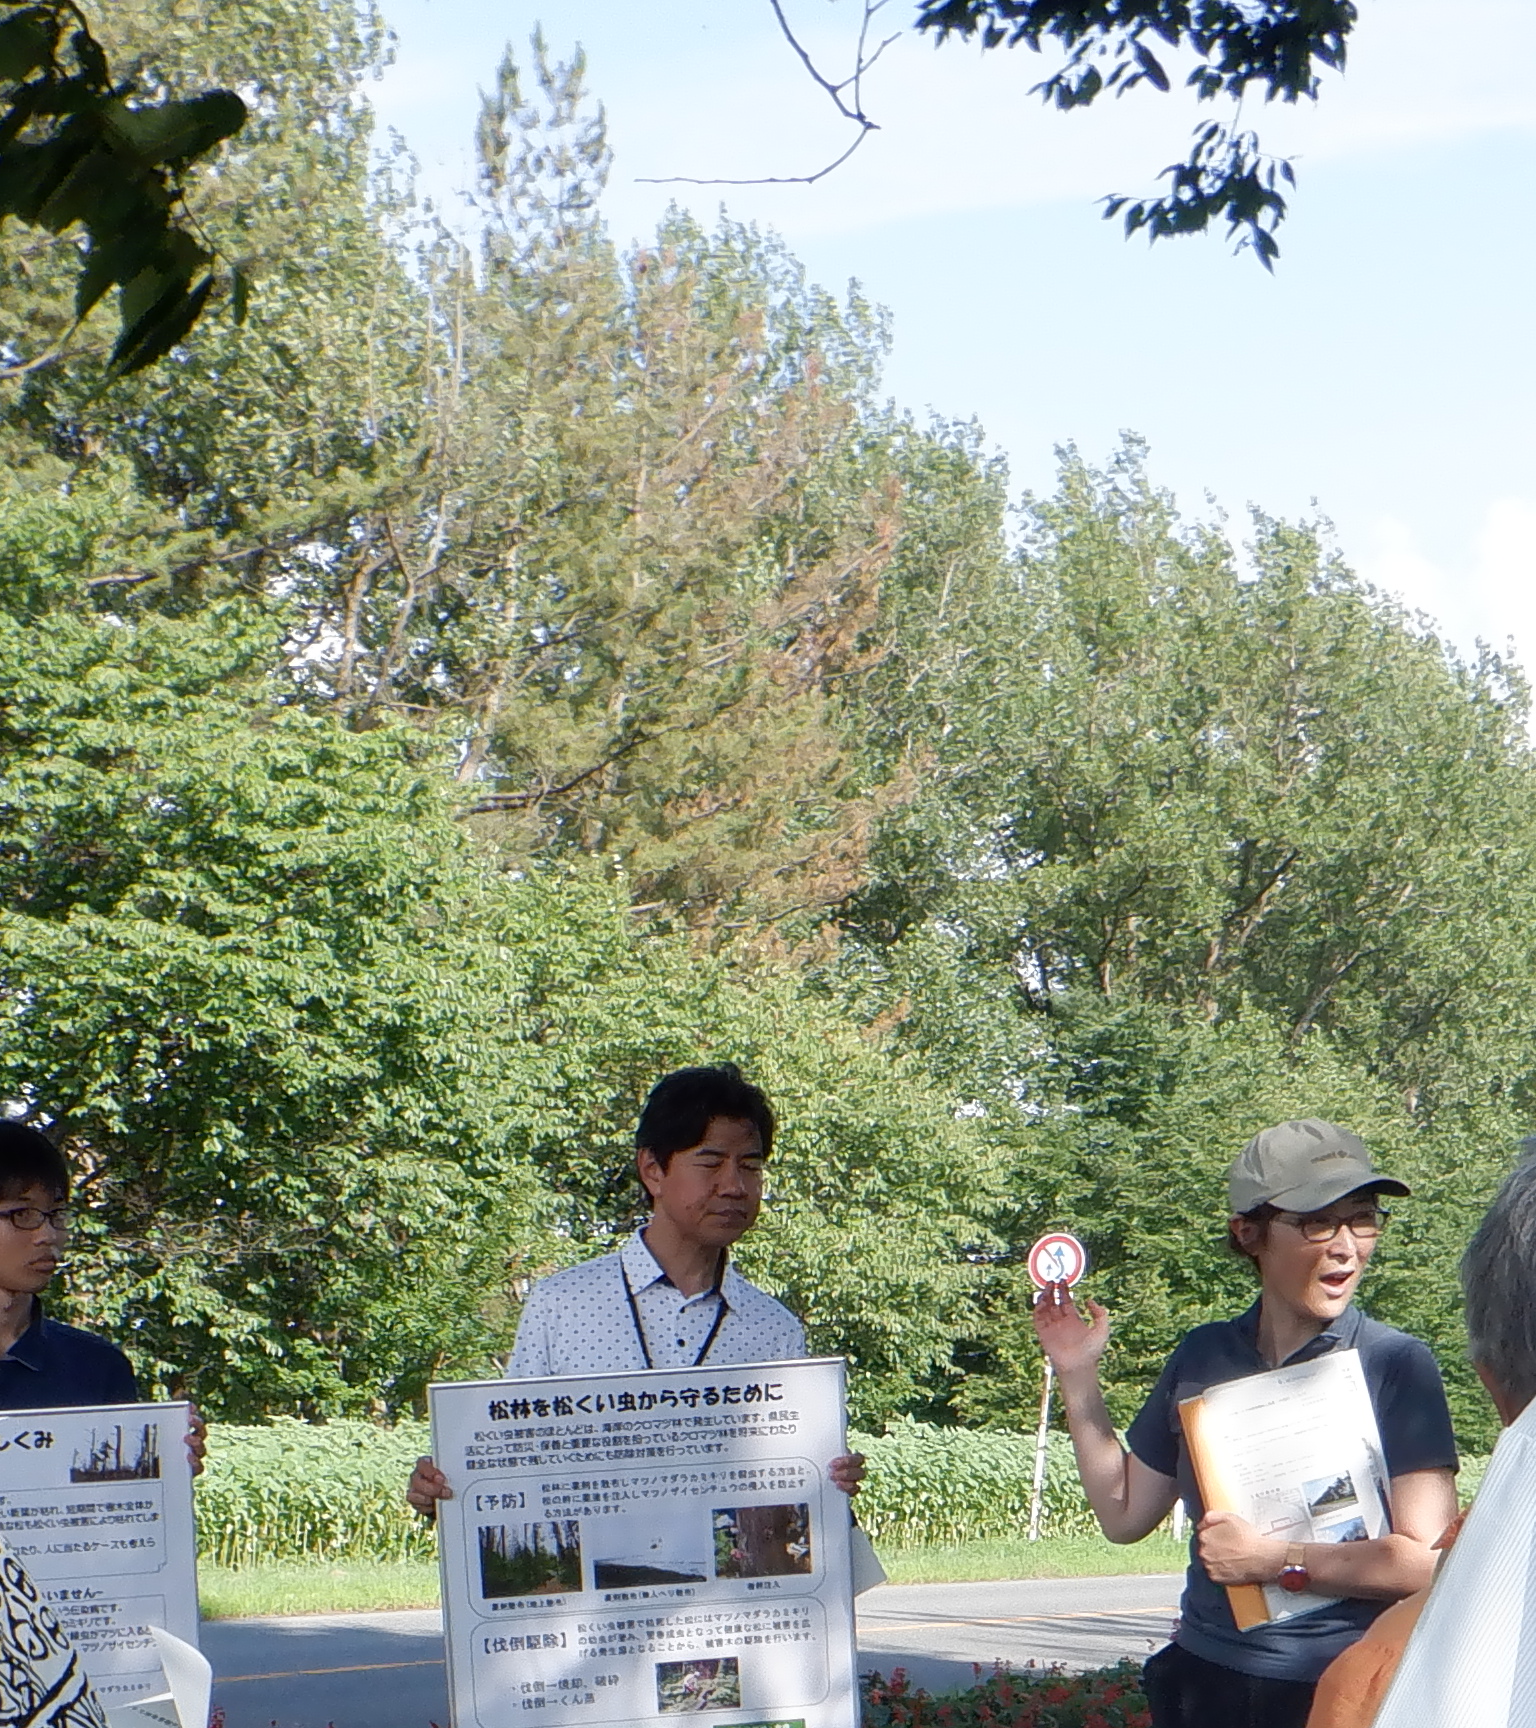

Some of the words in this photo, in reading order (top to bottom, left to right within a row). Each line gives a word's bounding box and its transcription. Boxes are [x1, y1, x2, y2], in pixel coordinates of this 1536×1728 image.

[488, 1383, 783, 1421] 松林を松くい虫から守るために
[475, 1491, 526, 1511] 【予防】
[483, 1632, 567, 1654] 【伐倒駆除】
